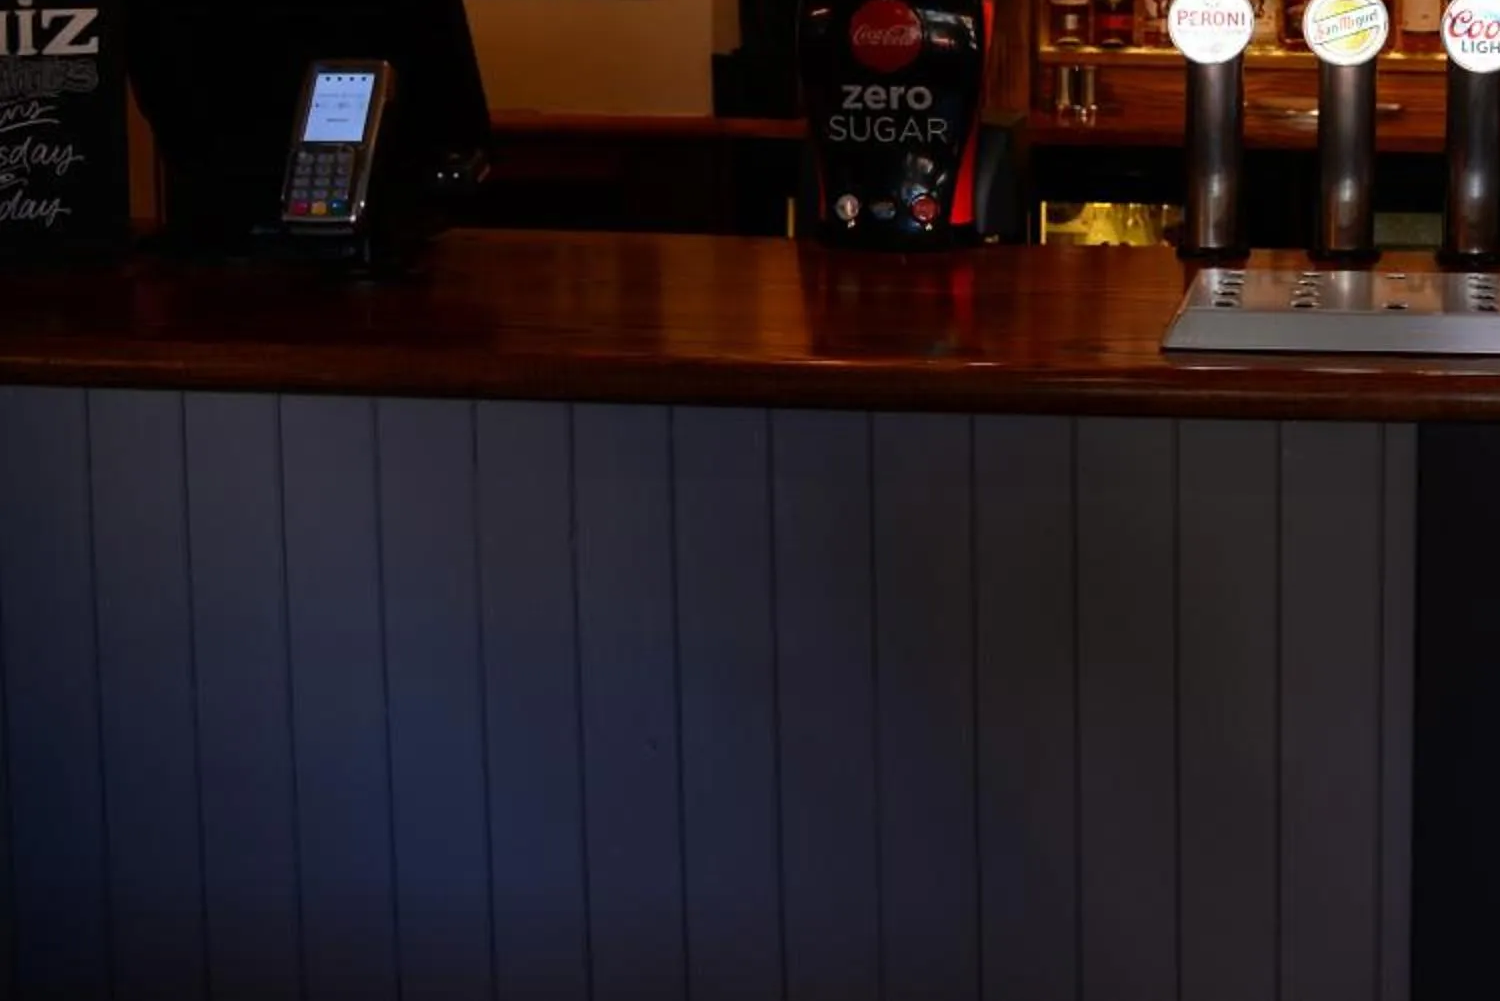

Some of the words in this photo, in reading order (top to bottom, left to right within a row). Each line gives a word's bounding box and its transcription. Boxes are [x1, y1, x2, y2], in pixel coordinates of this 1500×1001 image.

[1177, 10, 1245, 26] PERONI
[841, 84, 933, 111] zero
[829, 116, 948, 143] SUGAR
